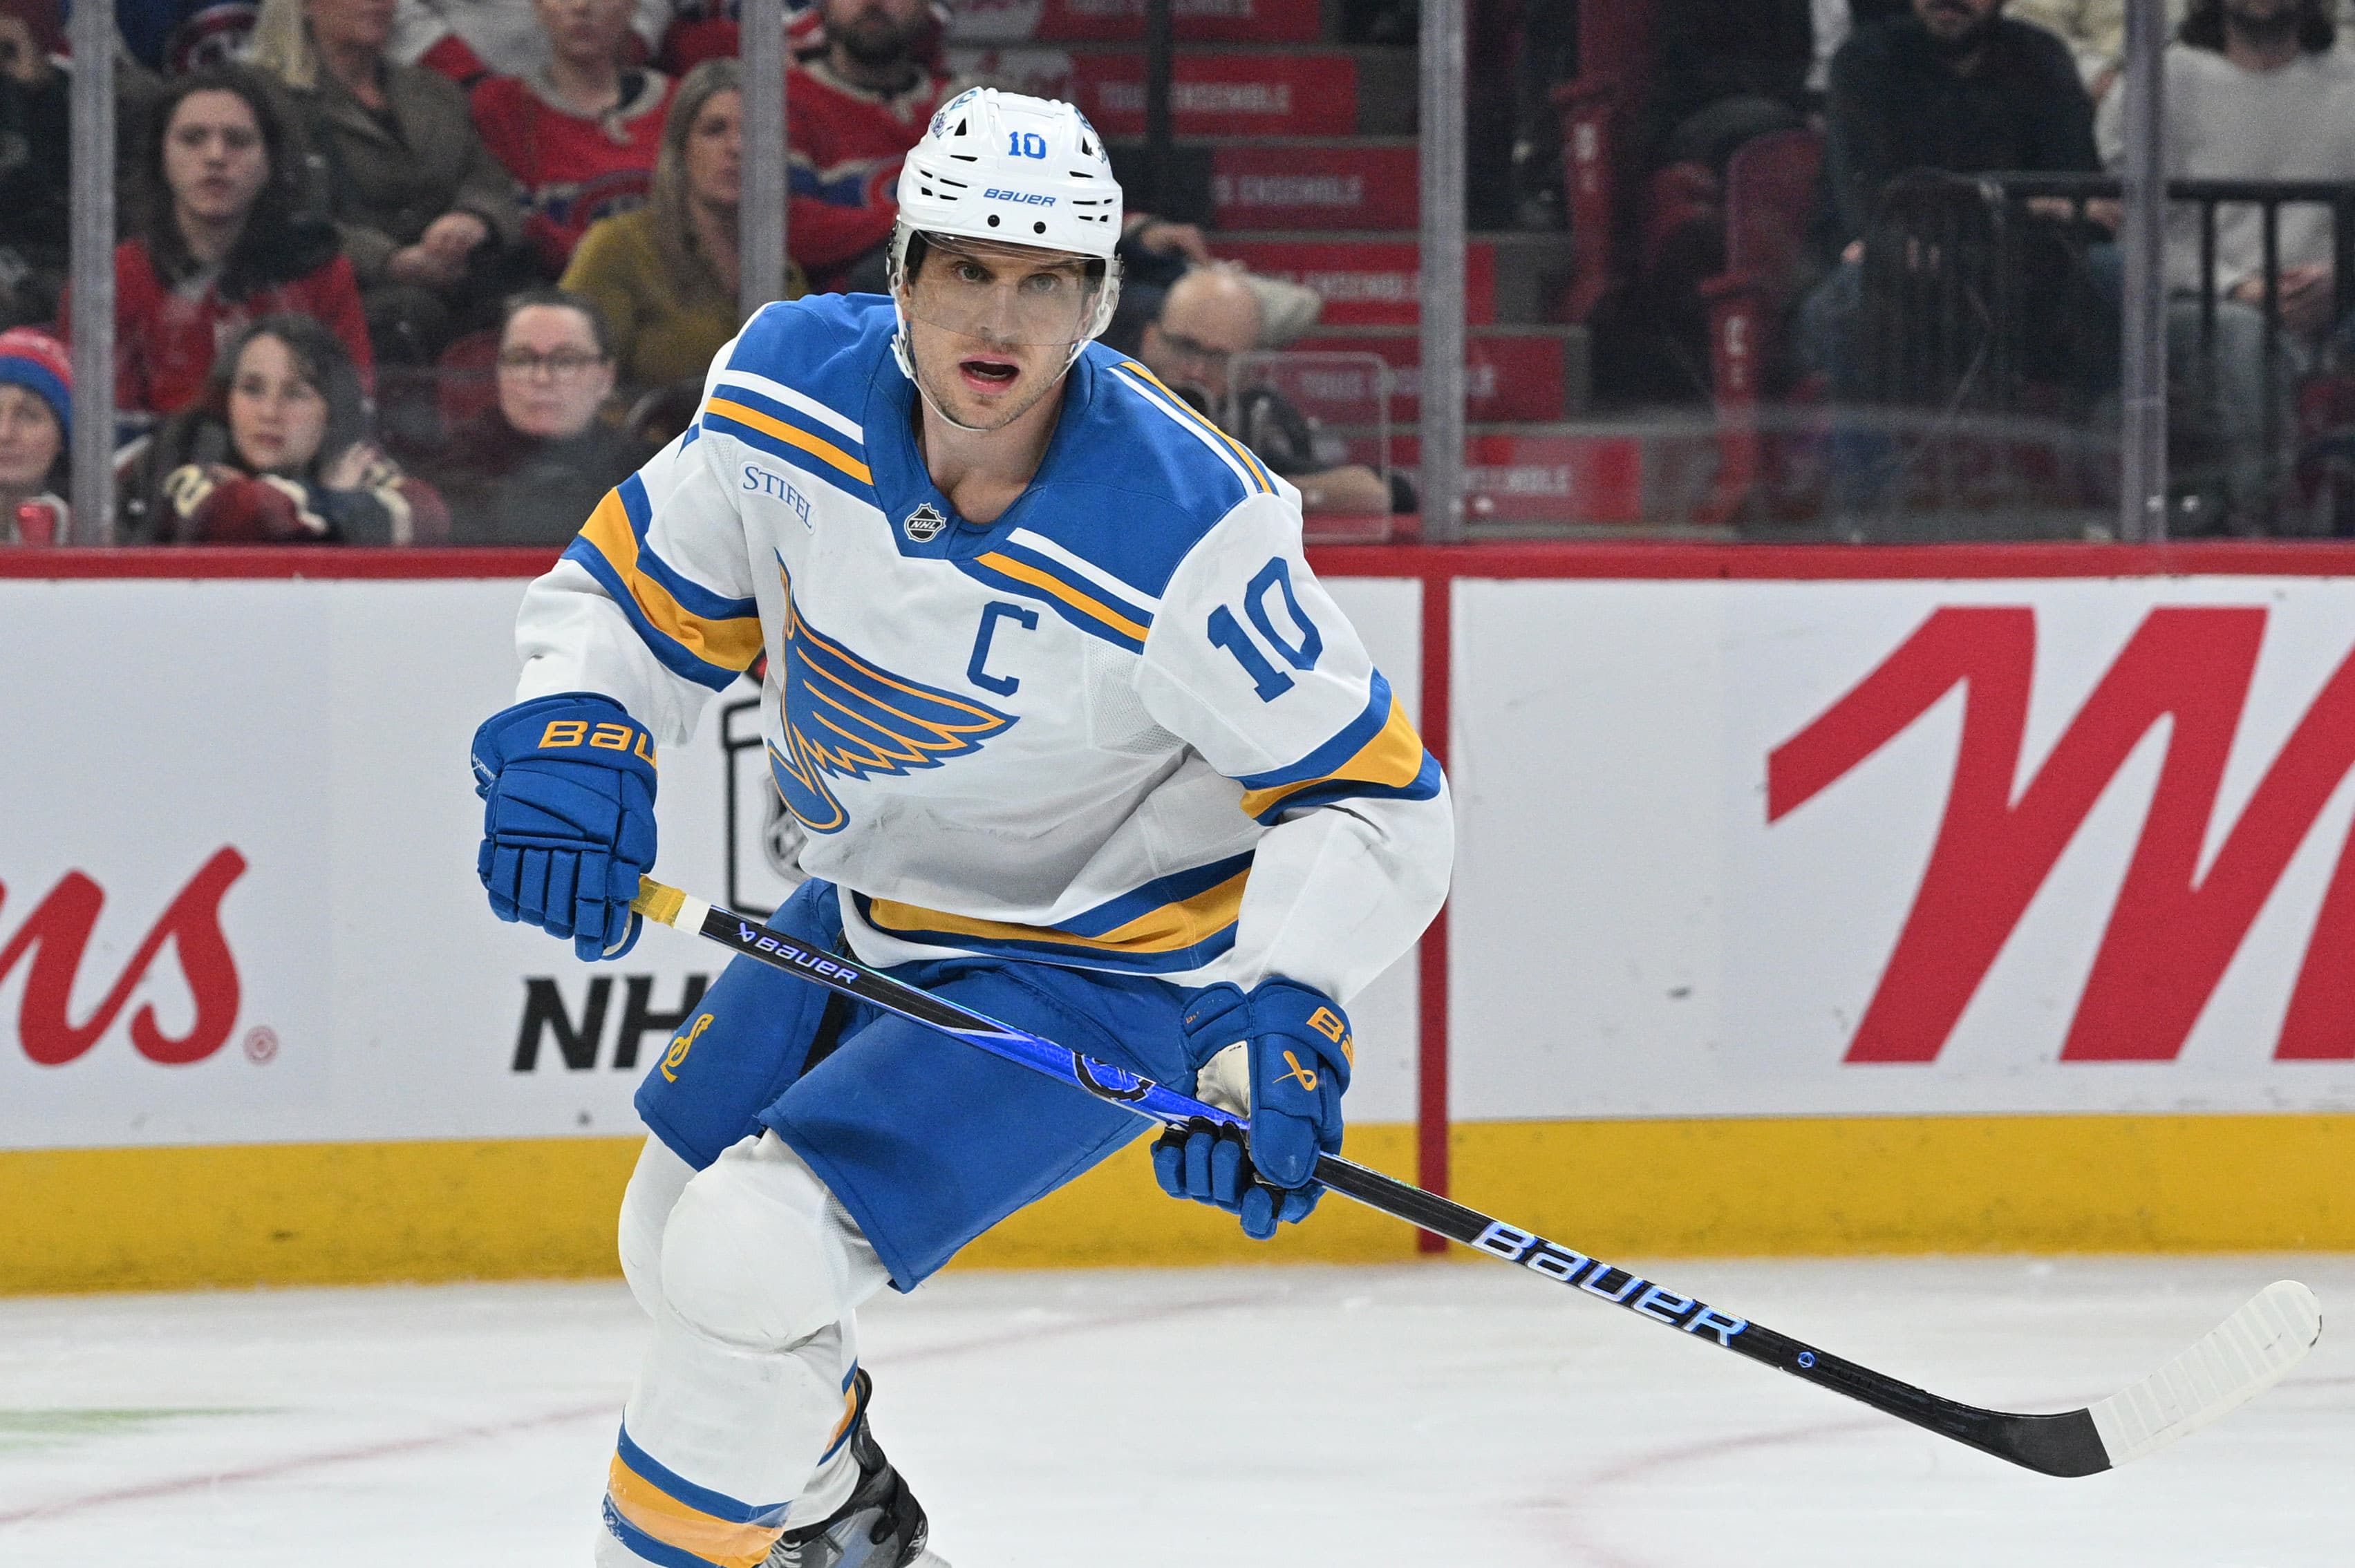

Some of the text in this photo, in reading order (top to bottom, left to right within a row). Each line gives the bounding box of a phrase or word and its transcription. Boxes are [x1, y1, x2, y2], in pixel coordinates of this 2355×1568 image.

[1007, 131, 1047, 160] 10
[742, 466, 812, 529] STIFEL
[910, 520, 937, 530] NHL
[967, 600, 1040, 697] C
[1207, 556, 1323, 703] 10
